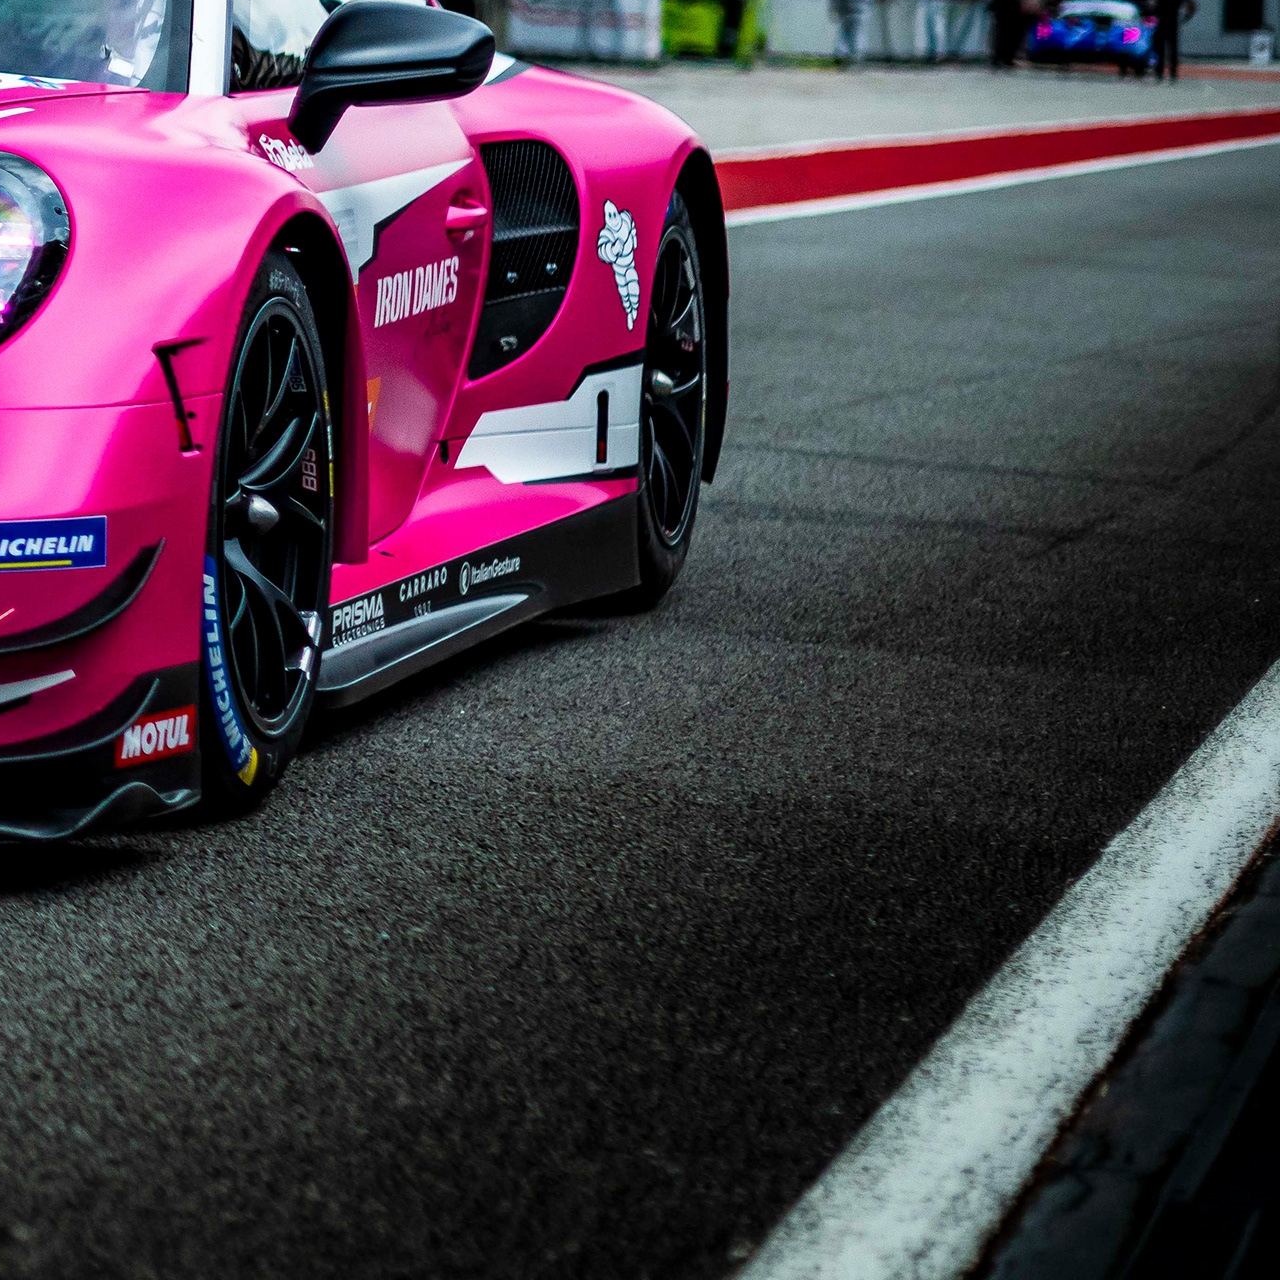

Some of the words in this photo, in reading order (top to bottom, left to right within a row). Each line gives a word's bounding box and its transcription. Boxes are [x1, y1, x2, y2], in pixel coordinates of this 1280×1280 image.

[374, 269, 413, 328] IRON
[412, 255, 459, 316] DAMES
[399, 566, 448, 603] CARRARO
[332, 592, 385, 635] PRISMA
[332, 617, 386, 648] ELECTRONICS
[203, 573, 242, 749] MICHELIN
[121, 714, 189, 760] MOTUL
